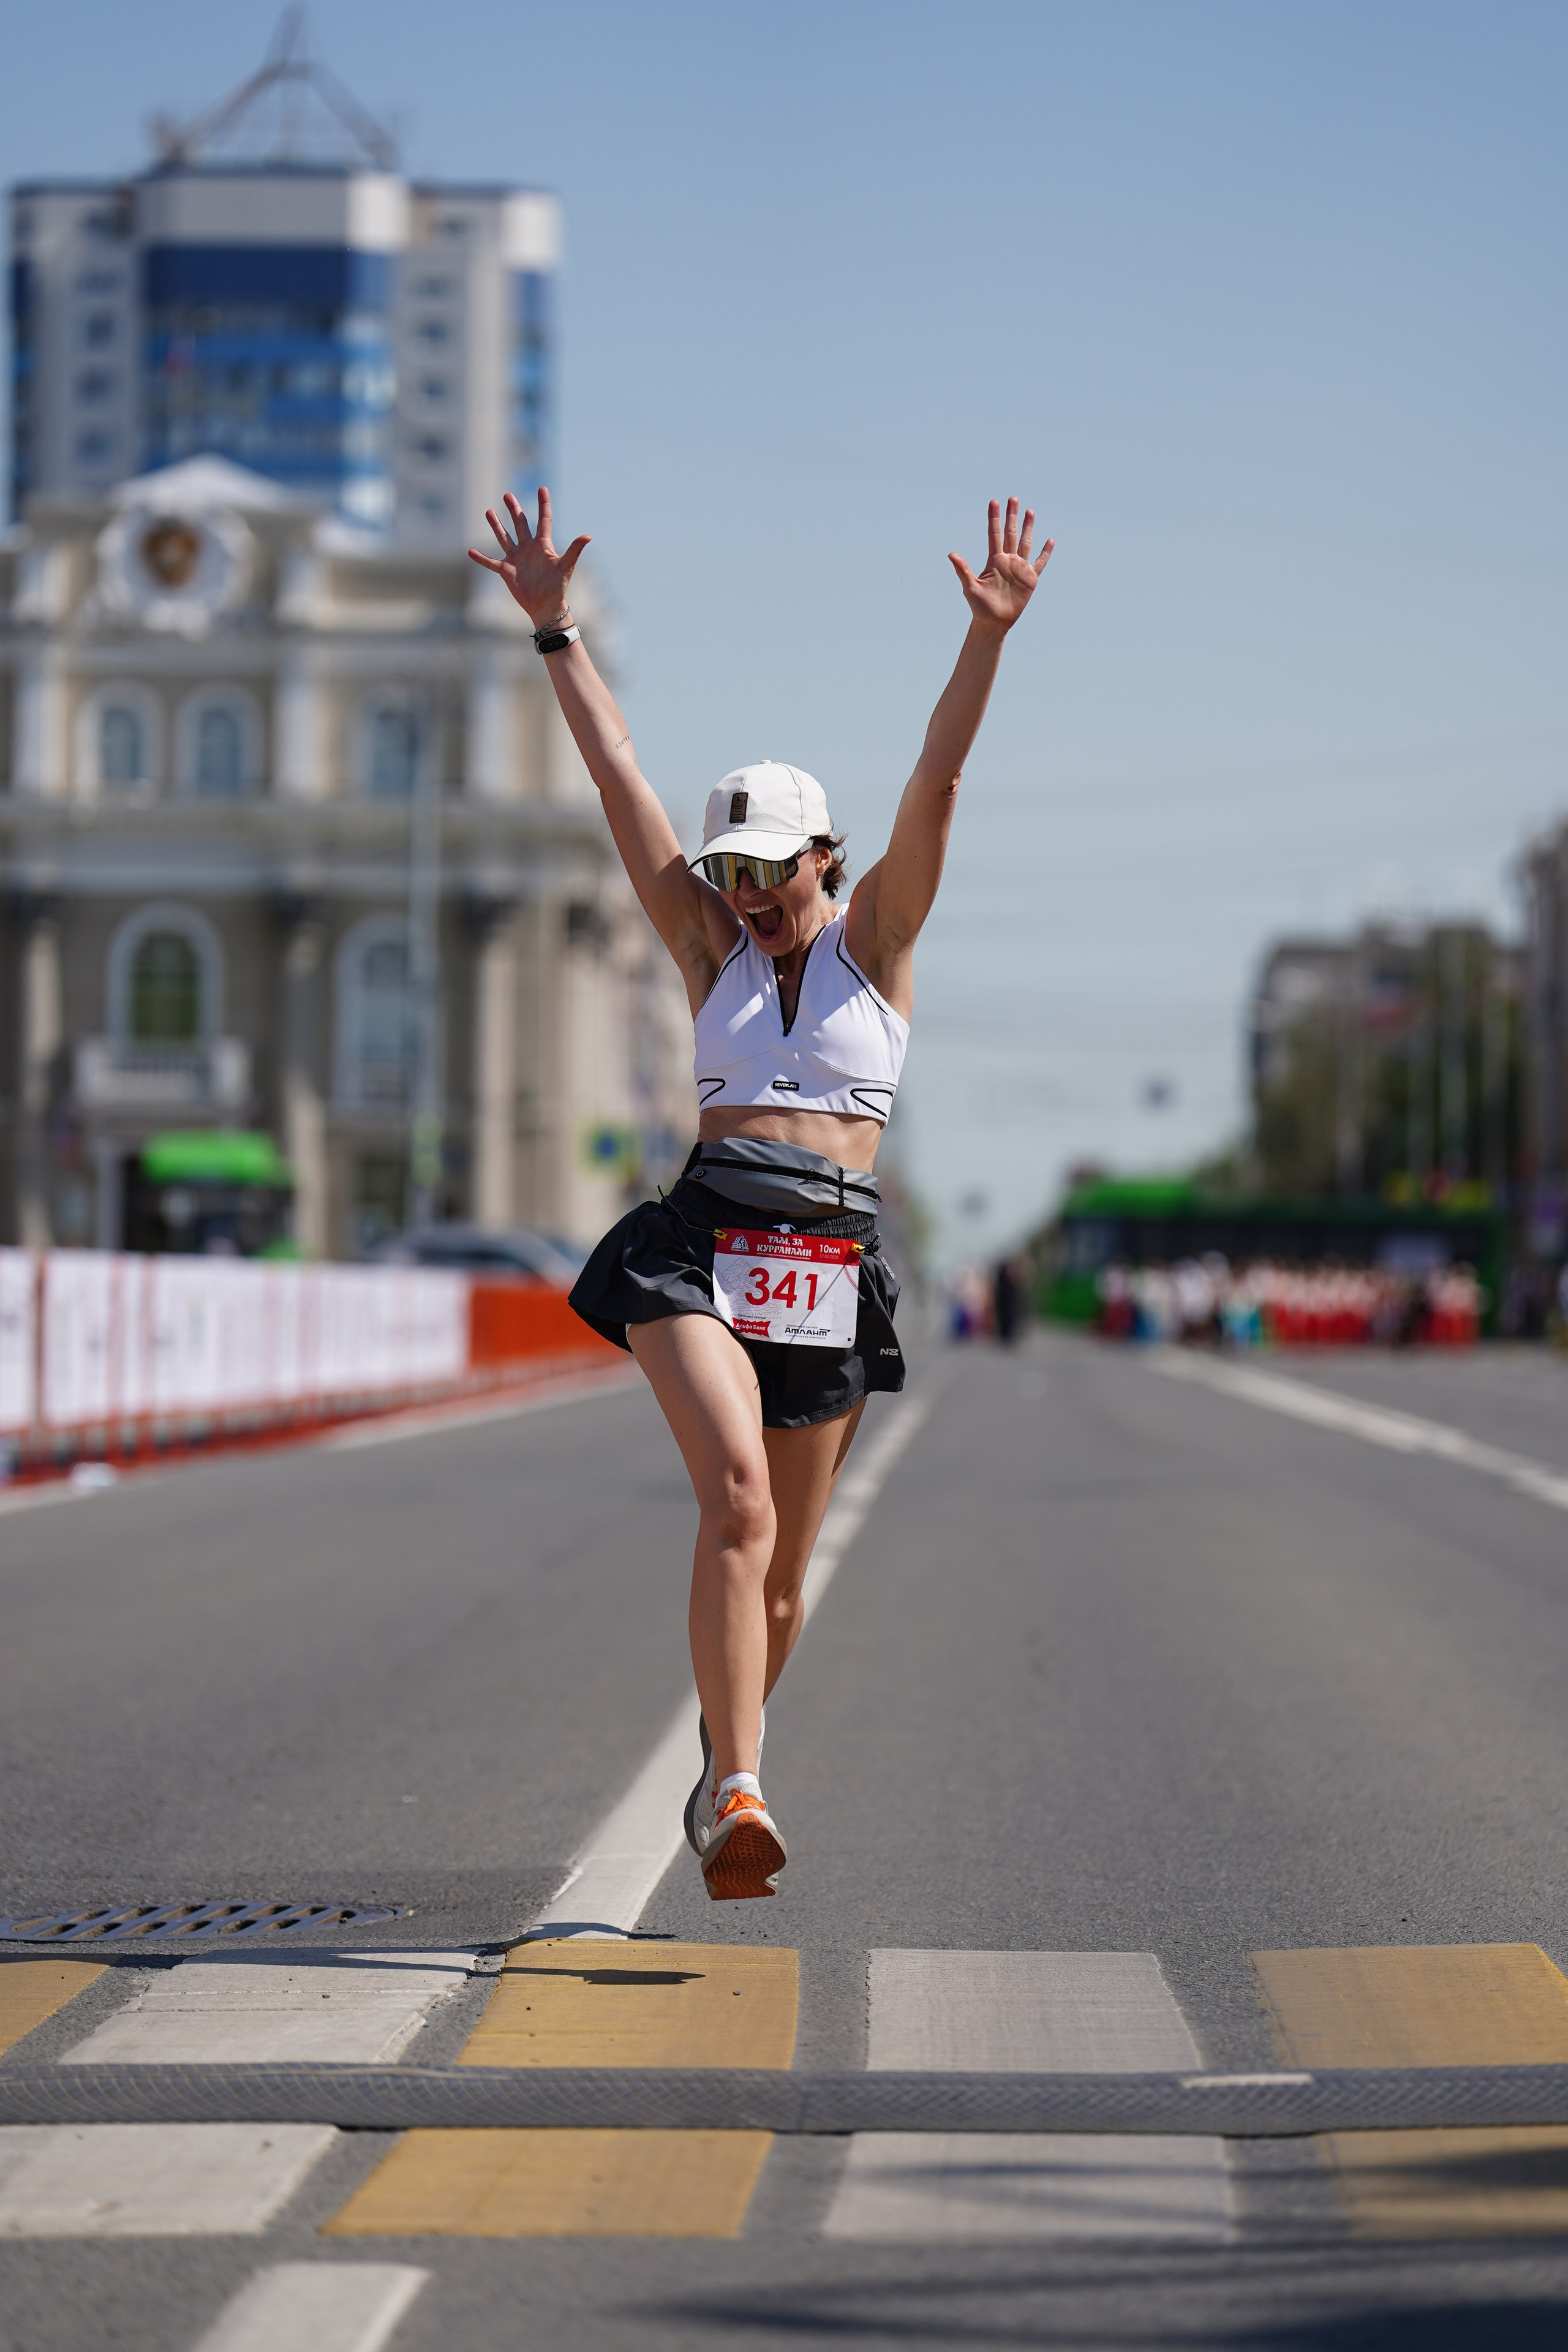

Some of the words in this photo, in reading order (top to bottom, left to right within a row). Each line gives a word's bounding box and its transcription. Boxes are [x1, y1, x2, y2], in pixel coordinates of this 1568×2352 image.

[767, 1235, 791, 1246] ТАМ,
[792, 1238, 803, 1246] ЗА
[756, 1244, 812, 1257] КУРГАНАМИ
[745, 1267, 818, 1310] 341
